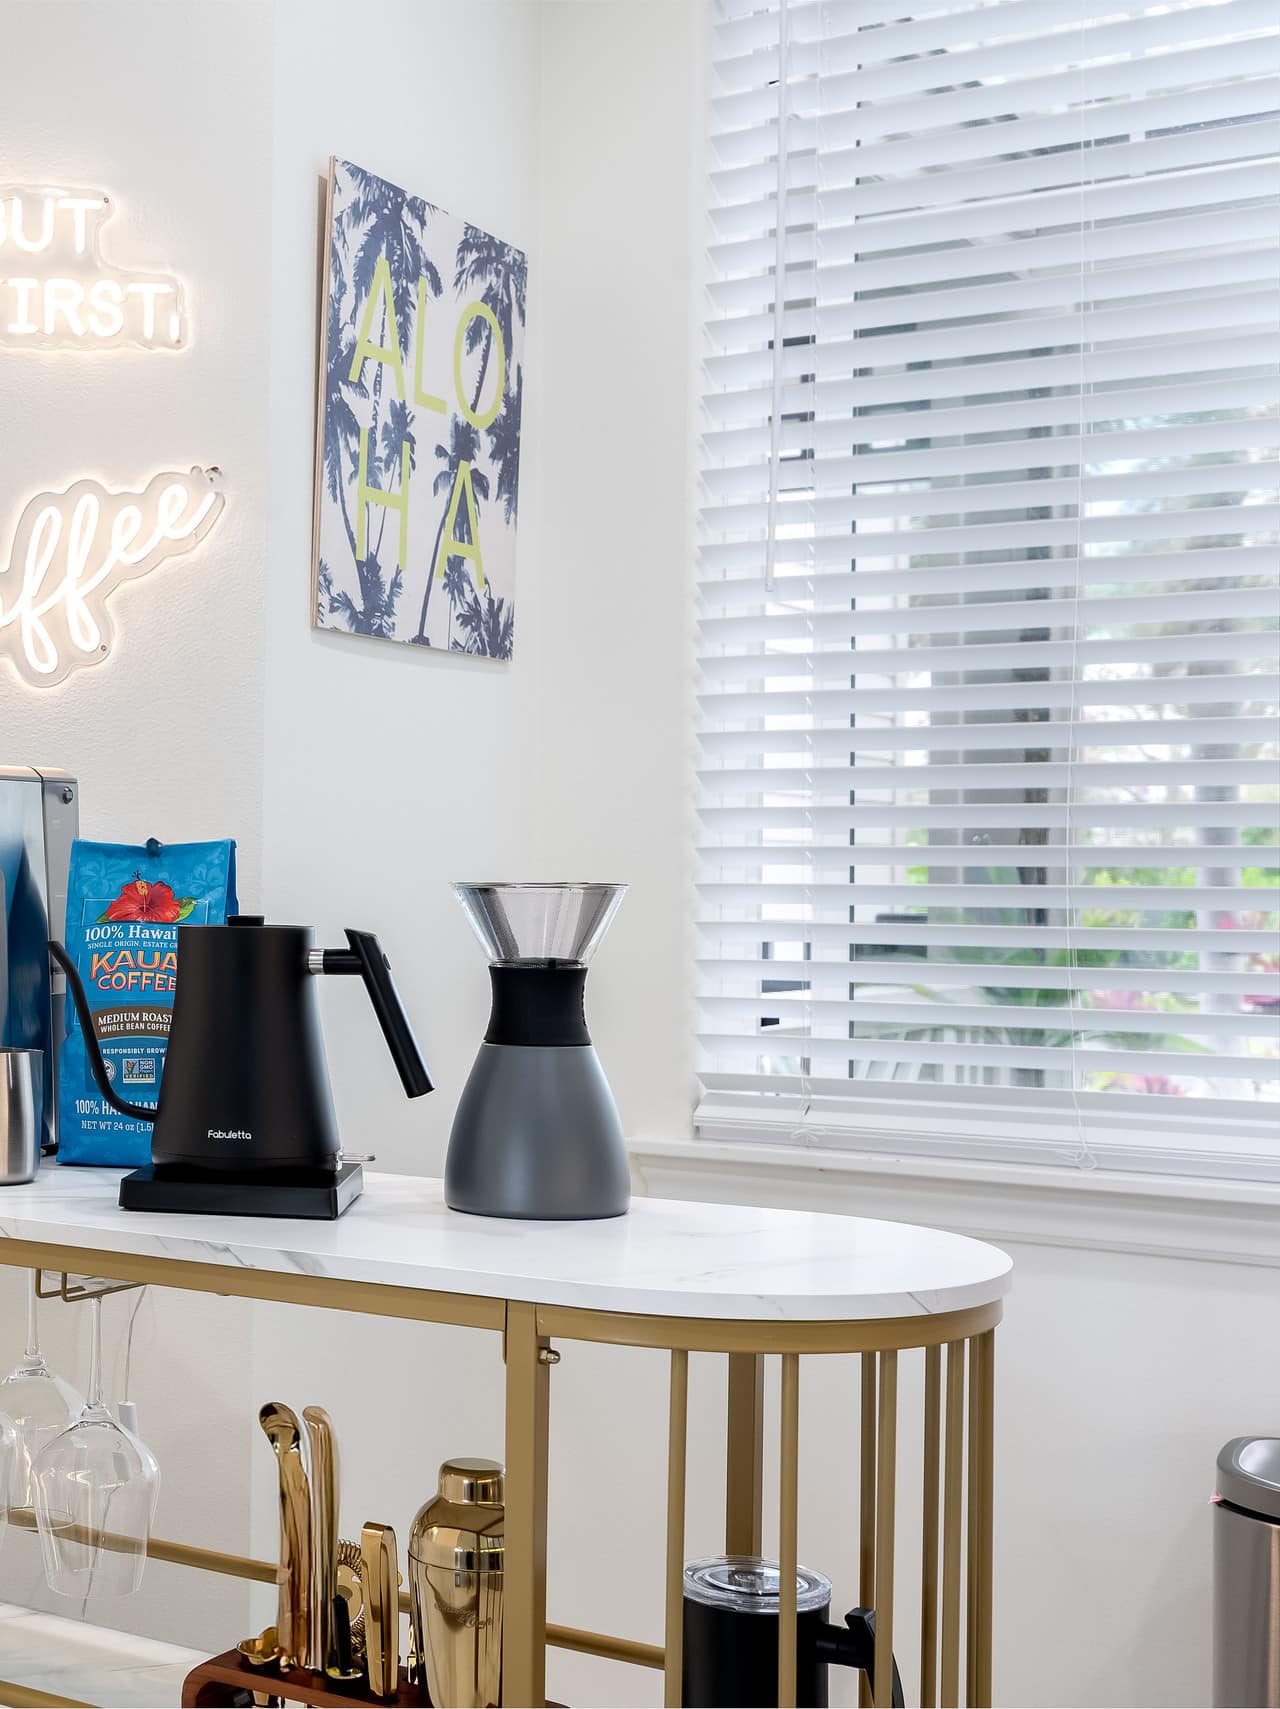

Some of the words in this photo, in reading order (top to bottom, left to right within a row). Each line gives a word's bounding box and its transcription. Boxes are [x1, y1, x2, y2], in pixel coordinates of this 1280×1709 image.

[85, 925, 124, 942] 100%
[87, 941, 113, 950] SINGLE
[142, 940, 168, 949] ESTATE
[97, 971, 176, 992] COFFEE
[98, 1012, 140, 1026] MEDIUM
[100, 1023, 125, 1033] WHOLE
[126, 1022, 145, 1032] BEAN
[102, 1047, 145, 1055] RESPONSIBLY
[75, 1099, 100, 1115] 100%
[81, 1120, 98, 1130] NET
[100, 1121, 112, 1130] WT
[113, 1121, 123, 1131] 24
[207, 1129, 252, 1140] Fabuletta
